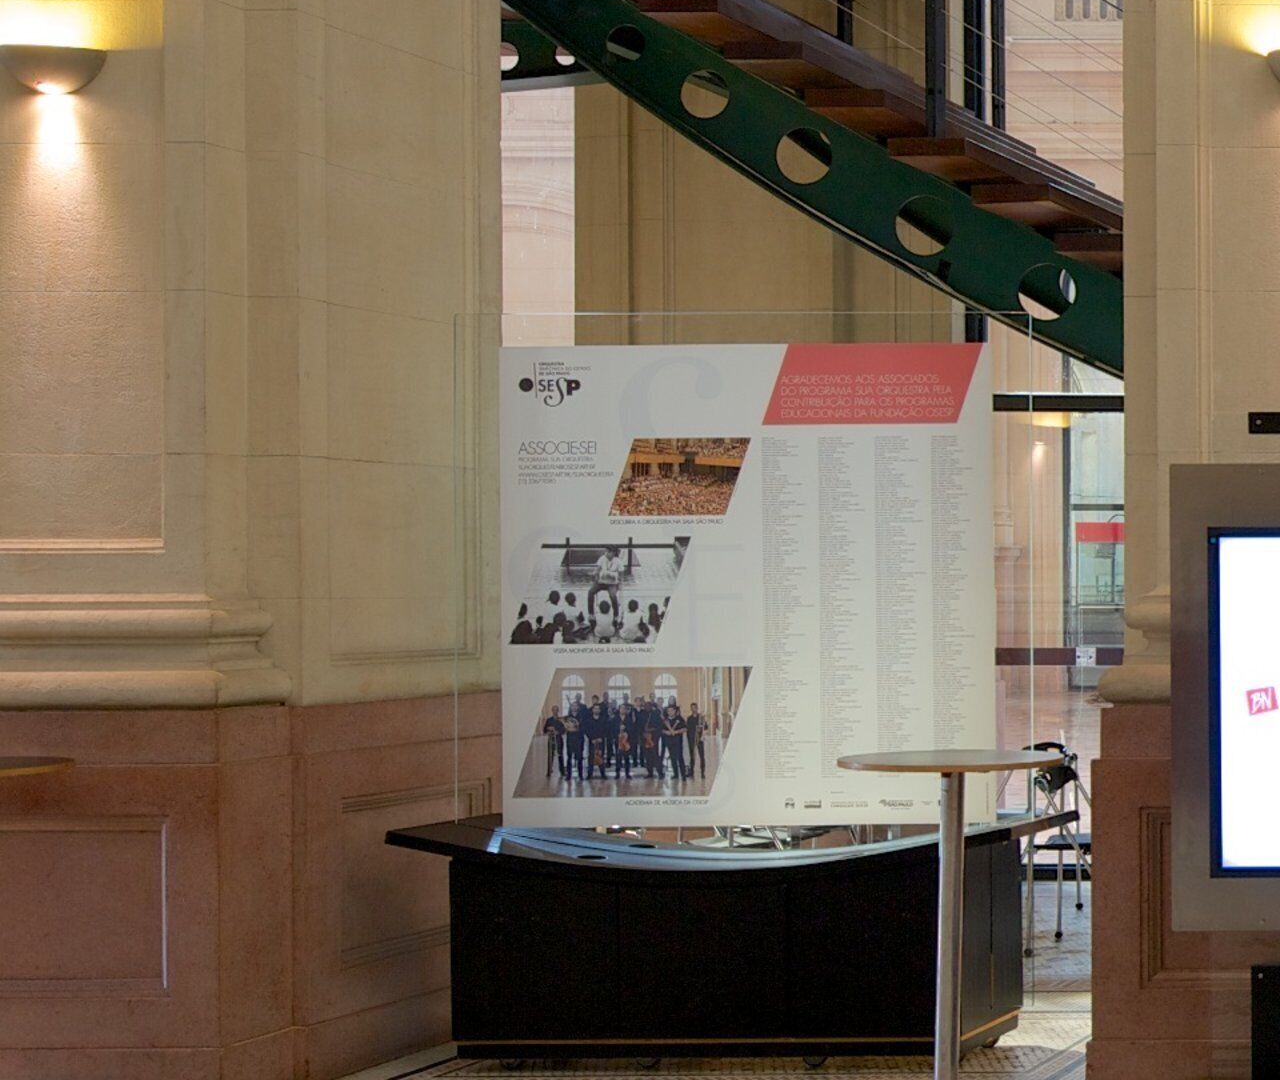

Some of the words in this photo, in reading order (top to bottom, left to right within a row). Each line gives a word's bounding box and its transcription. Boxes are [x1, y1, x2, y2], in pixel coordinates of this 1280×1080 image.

[781, 374, 851, 385] AGRADECEMOS
[855, 374, 875, 384] AOS
[877, 373, 939, 384] ASSOCIADOS
[781, 386, 796, 396] DO
[799, 385, 851, 395] PROGRAMA
[855, 385, 873, 395] SUA
[876, 384, 930, 395] ORQUESTRA
[932, 384, 952, 394] PELA
[781, 396, 851, 408] CONTRIBUIÇÃO
[854, 397, 876, 407] PARA
[878, 397, 892, 407] OS
[895, 396, 955, 407] PROGRAMAS
[781, 408, 851, 418] EDUCACIONAIS
[854, 408, 868, 418] DA
[870, 406, 923, 418] FUNDAÇÃO
[925, 407, 954, 417] OSESP
[1250, 687, 1273, 714] BN
